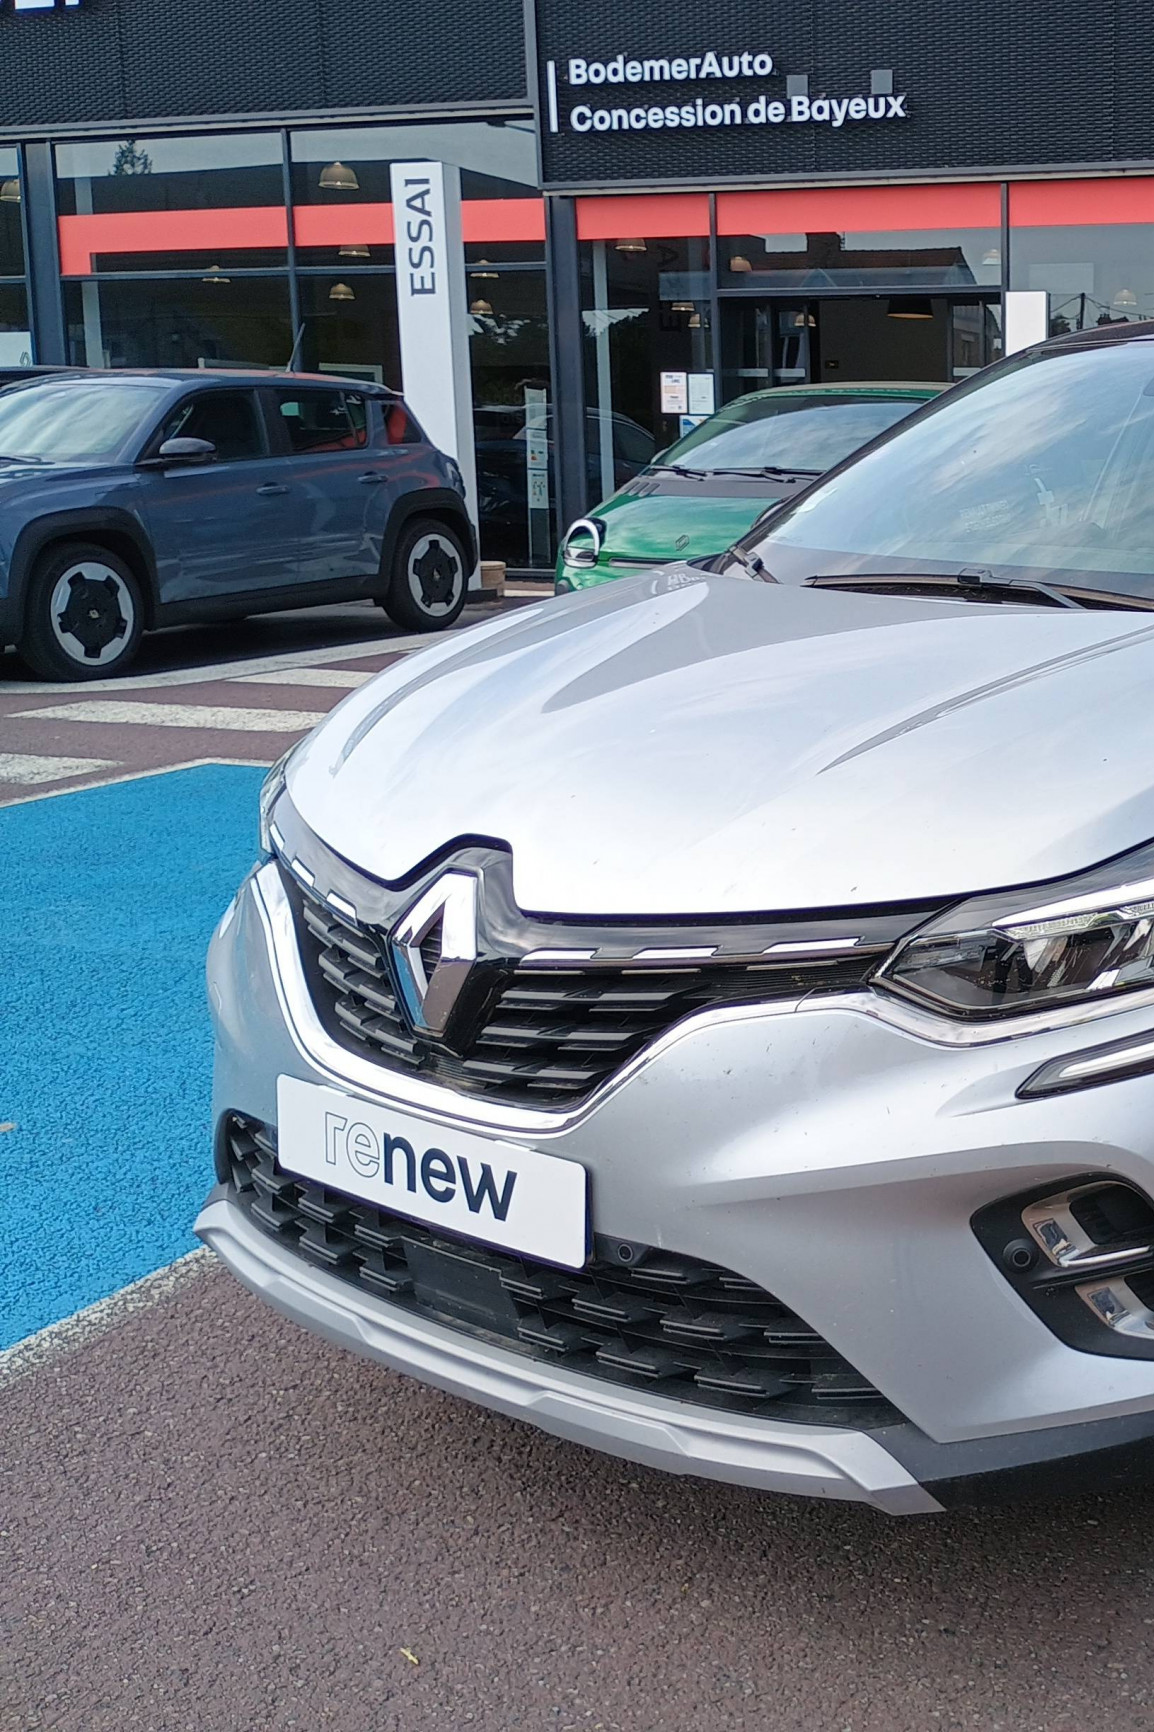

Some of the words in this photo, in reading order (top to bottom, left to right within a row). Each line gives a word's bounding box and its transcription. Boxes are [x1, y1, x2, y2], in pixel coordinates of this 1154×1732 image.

[568, 52, 774, 85] BodemerAuto
[569, 99, 743, 133] Concession
[747, 96, 785, 125] de
[790, 93, 907, 127] Bayeux
[404, 178, 437, 296] ESSAI
[324, 1111, 518, 1222] renew
